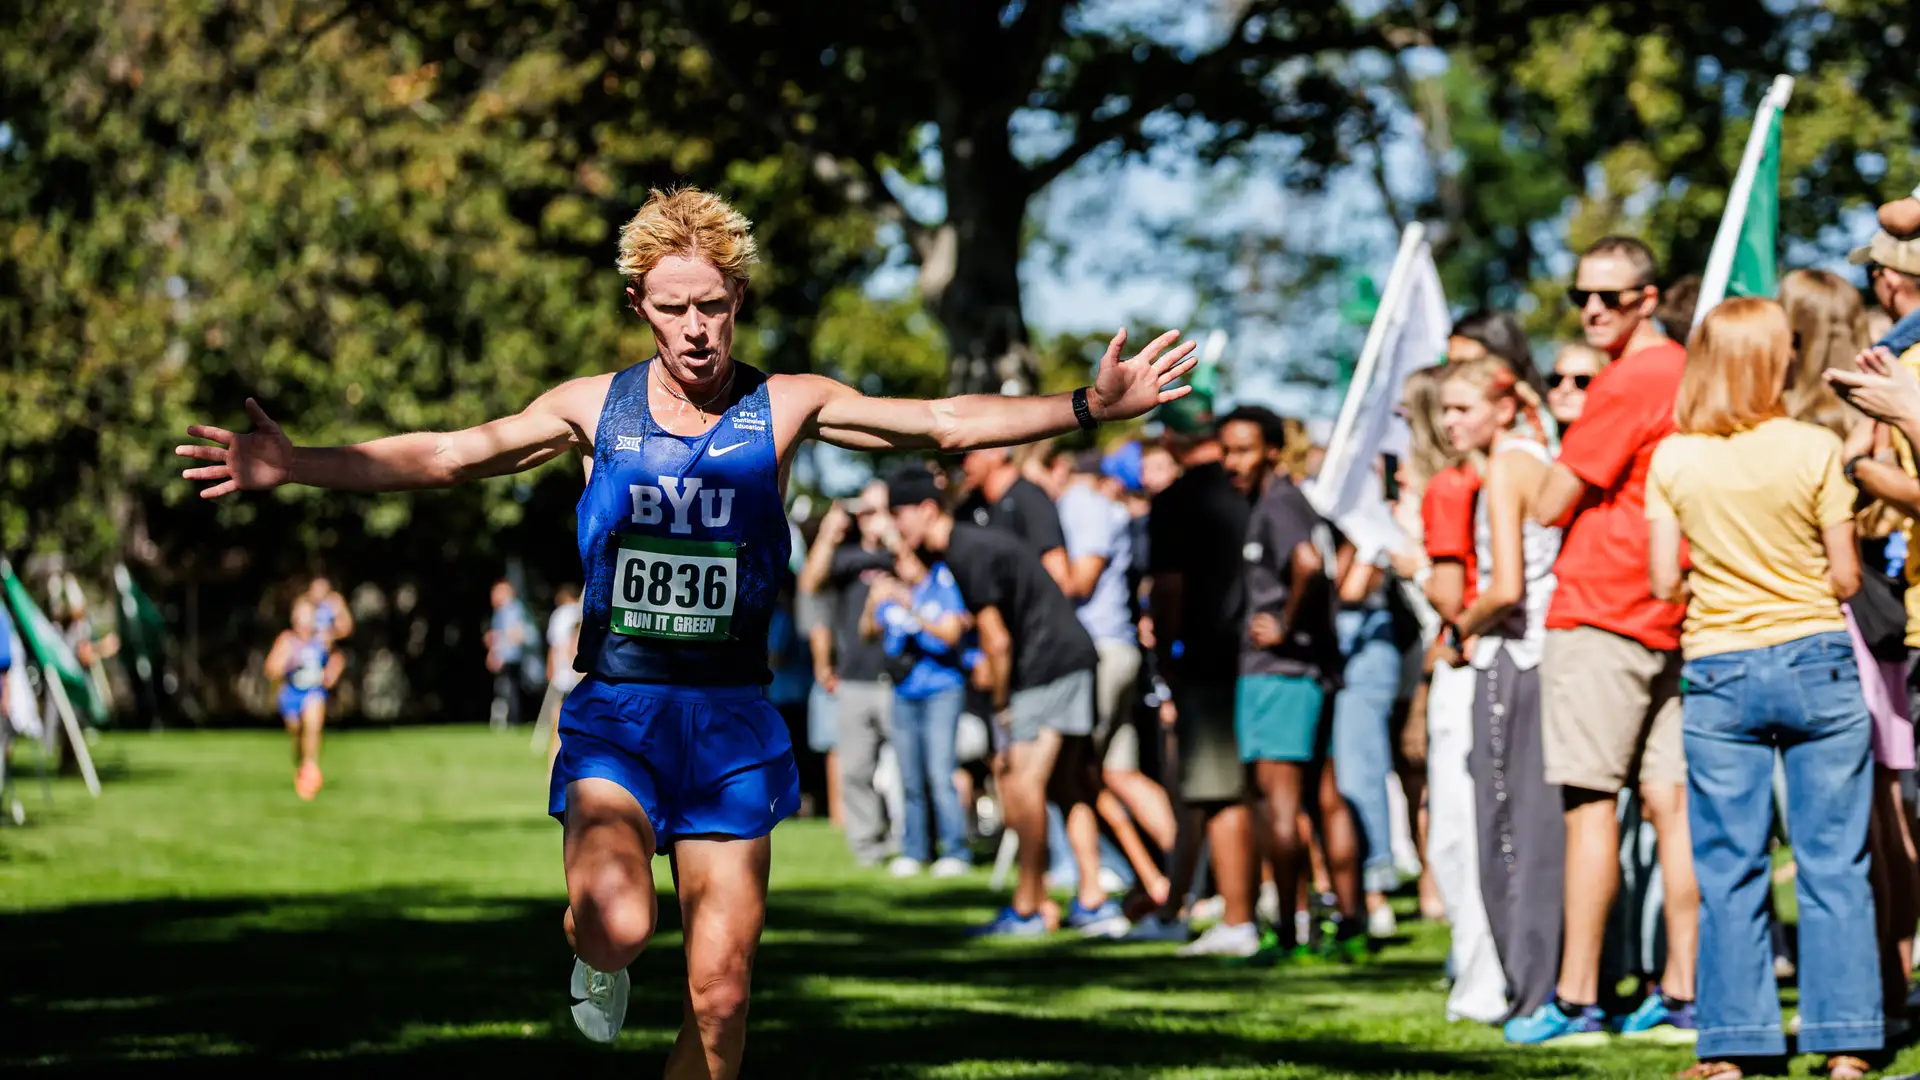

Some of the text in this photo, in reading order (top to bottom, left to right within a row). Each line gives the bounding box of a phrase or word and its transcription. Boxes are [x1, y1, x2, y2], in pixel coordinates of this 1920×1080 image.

[732, 417, 766, 426] Continuing
[733, 423, 765, 431] Education
[629, 475, 736, 534] BYU
[622, 558, 728, 610] 6836
[623, 610, 716, 633] RUN IT GREEN
